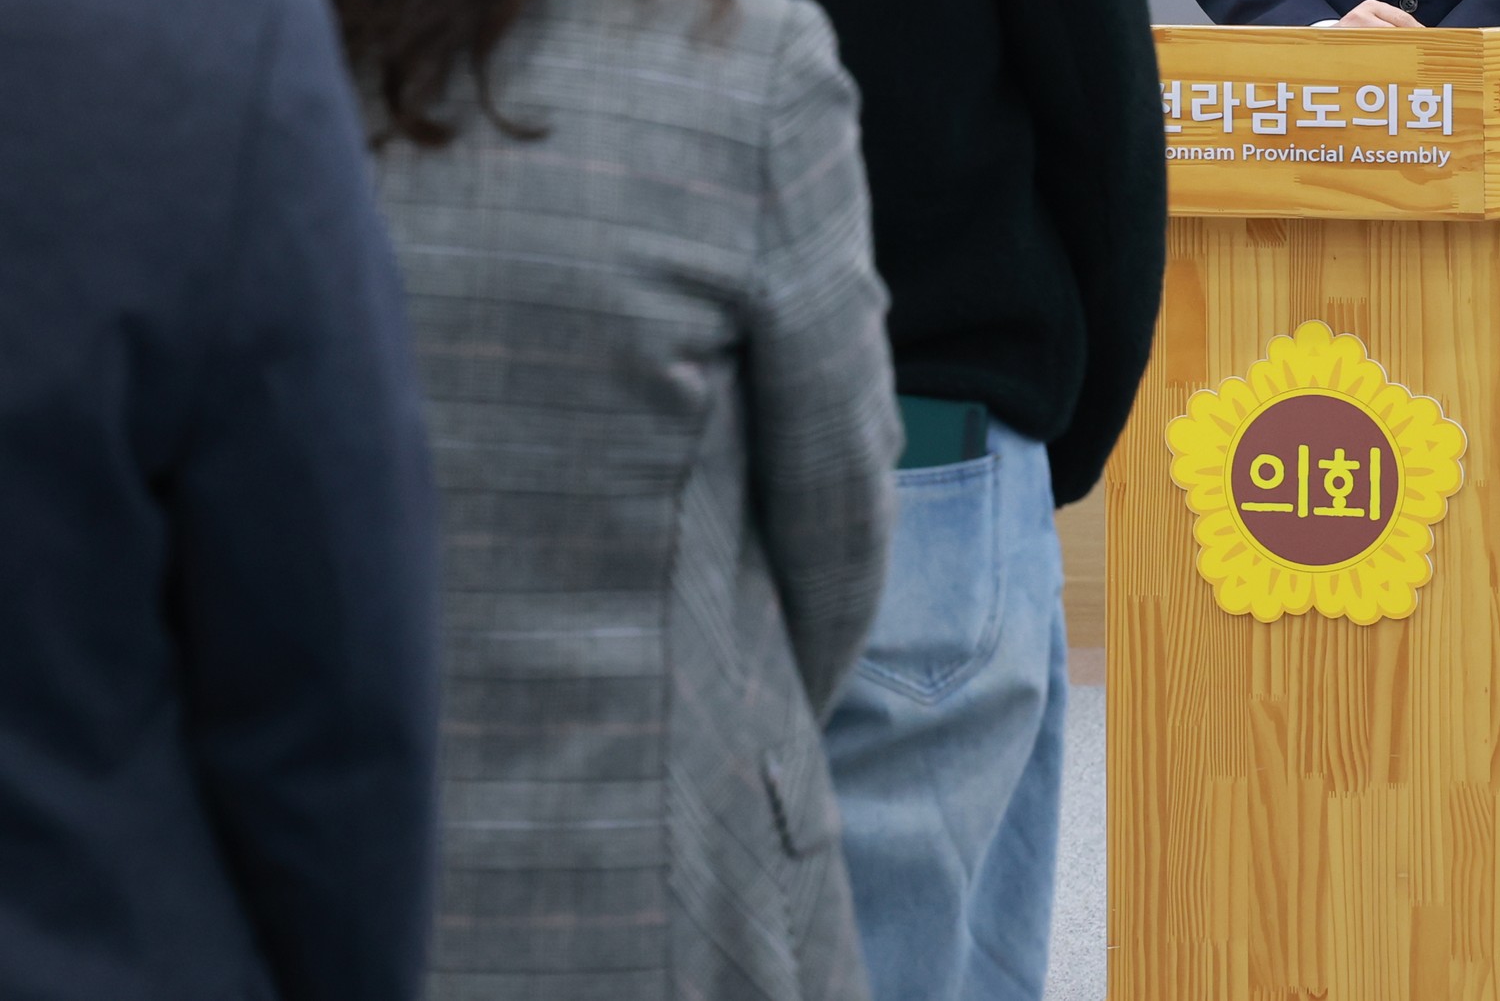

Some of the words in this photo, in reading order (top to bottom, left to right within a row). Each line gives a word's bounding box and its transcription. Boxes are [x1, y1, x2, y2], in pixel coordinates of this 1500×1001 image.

[1242, 143, 1345, 163] Provincial
[1350, 145, 1451, 168] Assembly
[1240, 444, 1381, 521] 의회
